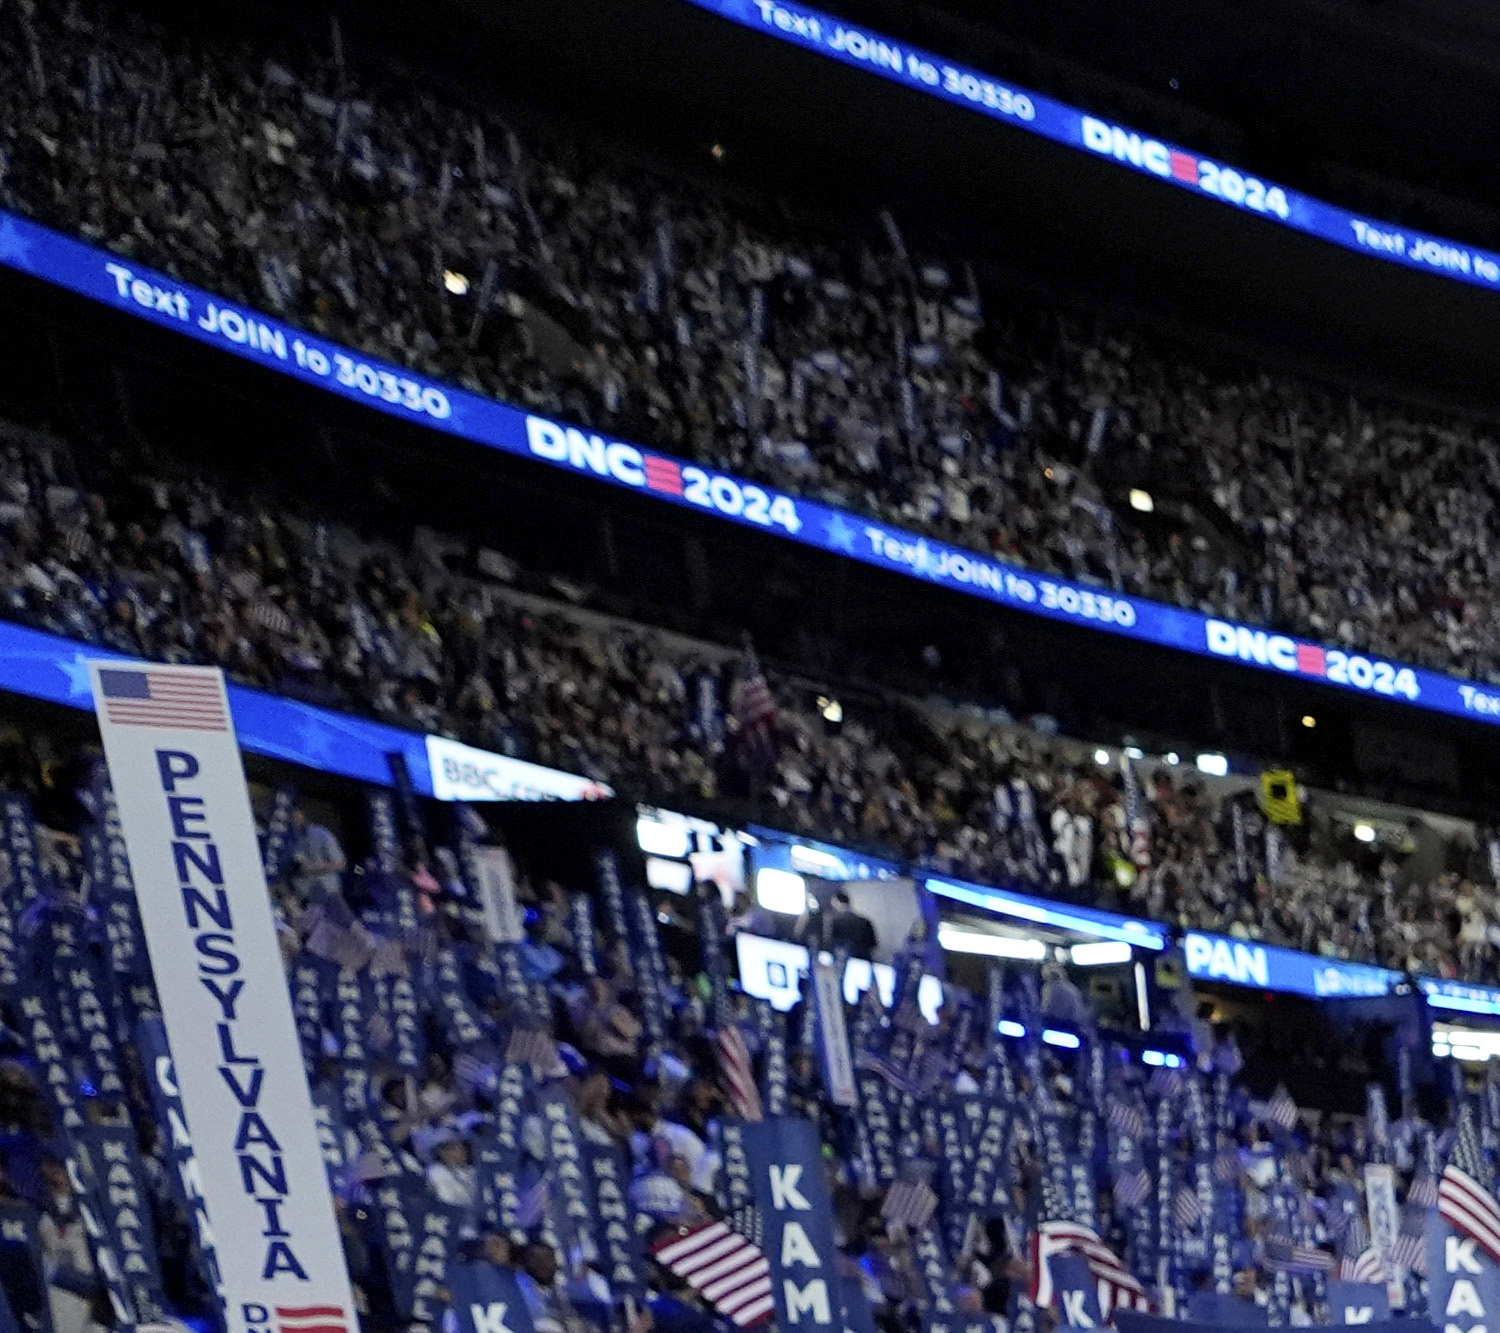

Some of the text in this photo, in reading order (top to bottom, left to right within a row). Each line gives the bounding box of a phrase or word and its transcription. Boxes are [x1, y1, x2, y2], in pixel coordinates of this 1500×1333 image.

[753, 0, 1034, 120] Text JOIN to 30330
[1082, 117, 1289, 218] DNC 2024
[106, 263, 451, 418] Text JOIN to 30330
[526, 416, 800, 532] DNC 2024
[1206, 620, 1418, 698] DNC 2024
[156, 749, 308, 1281] PENNSYLVANIA
